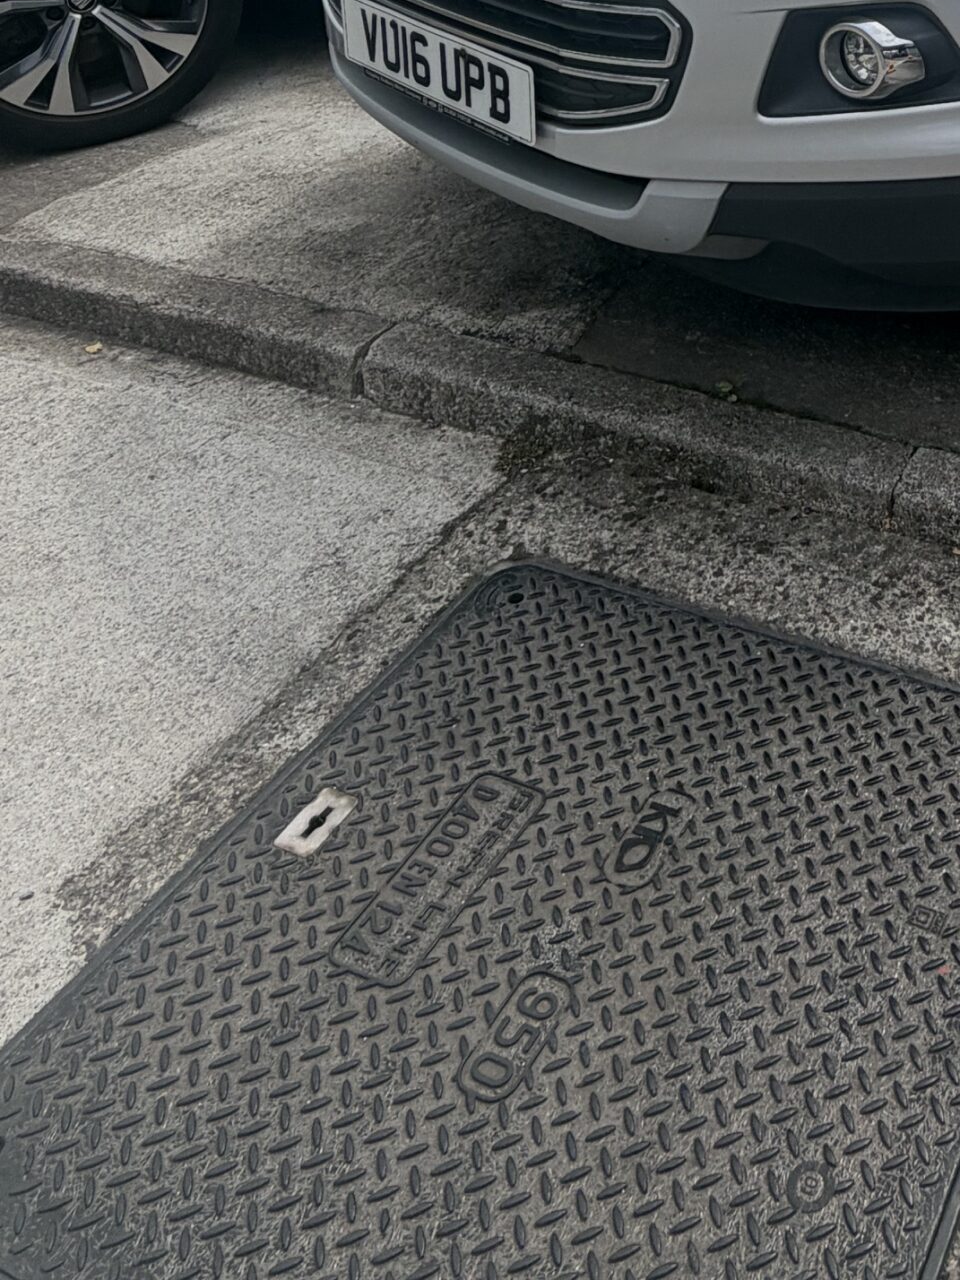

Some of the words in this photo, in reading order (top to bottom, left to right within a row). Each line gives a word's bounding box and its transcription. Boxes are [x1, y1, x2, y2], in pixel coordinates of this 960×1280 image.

[361, 8, 431, 88] VU16
[439, 41, 511, 124] UPB
[470, 987, 559, 1089] 950
